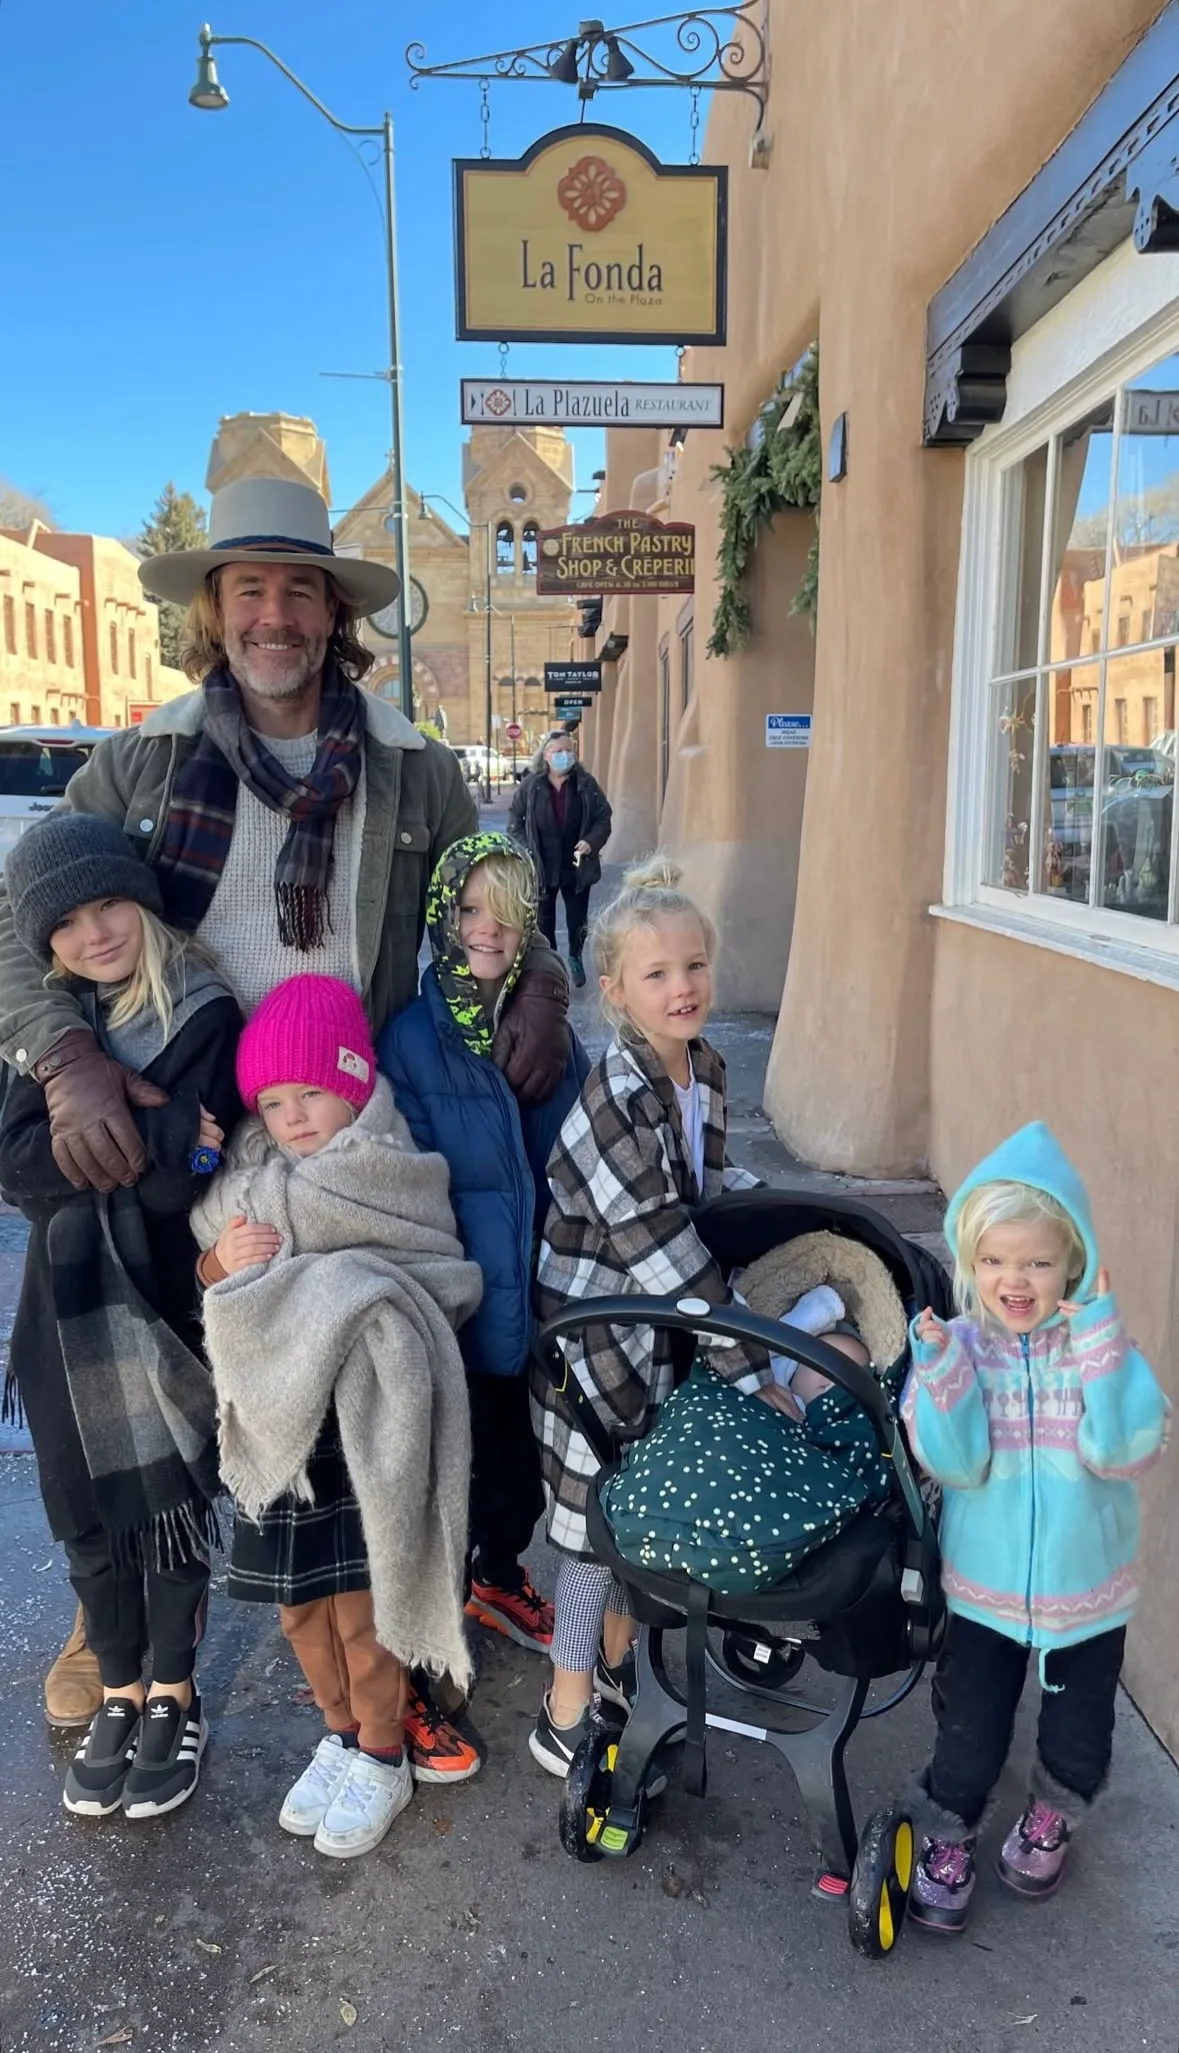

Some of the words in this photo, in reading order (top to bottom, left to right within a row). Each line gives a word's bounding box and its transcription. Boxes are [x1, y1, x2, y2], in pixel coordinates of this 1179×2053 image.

[521, 239, 557, 289] La
[567, 243, 664, 301] Fonda
[585, 293, 604, 304] On
[608, 293, 625, 304] the
[630, 294, 662, 306] Plaza
[525, 389, 545, 416] La
[553, 389, 630, 417] Plazuela
[635, 399, 712, 412] RESTAURANT
[617, 519, 640, 529] THE
[562, 532, 624, 556] FRENCH
[630, 532, 692, 556] PASTRY
[556, 556, 602, 579] SHOP
[605, 559, 618, 576] &
[547, 671, 566, 679] TOM
[567, 671, 599, 679] TAYLOR
